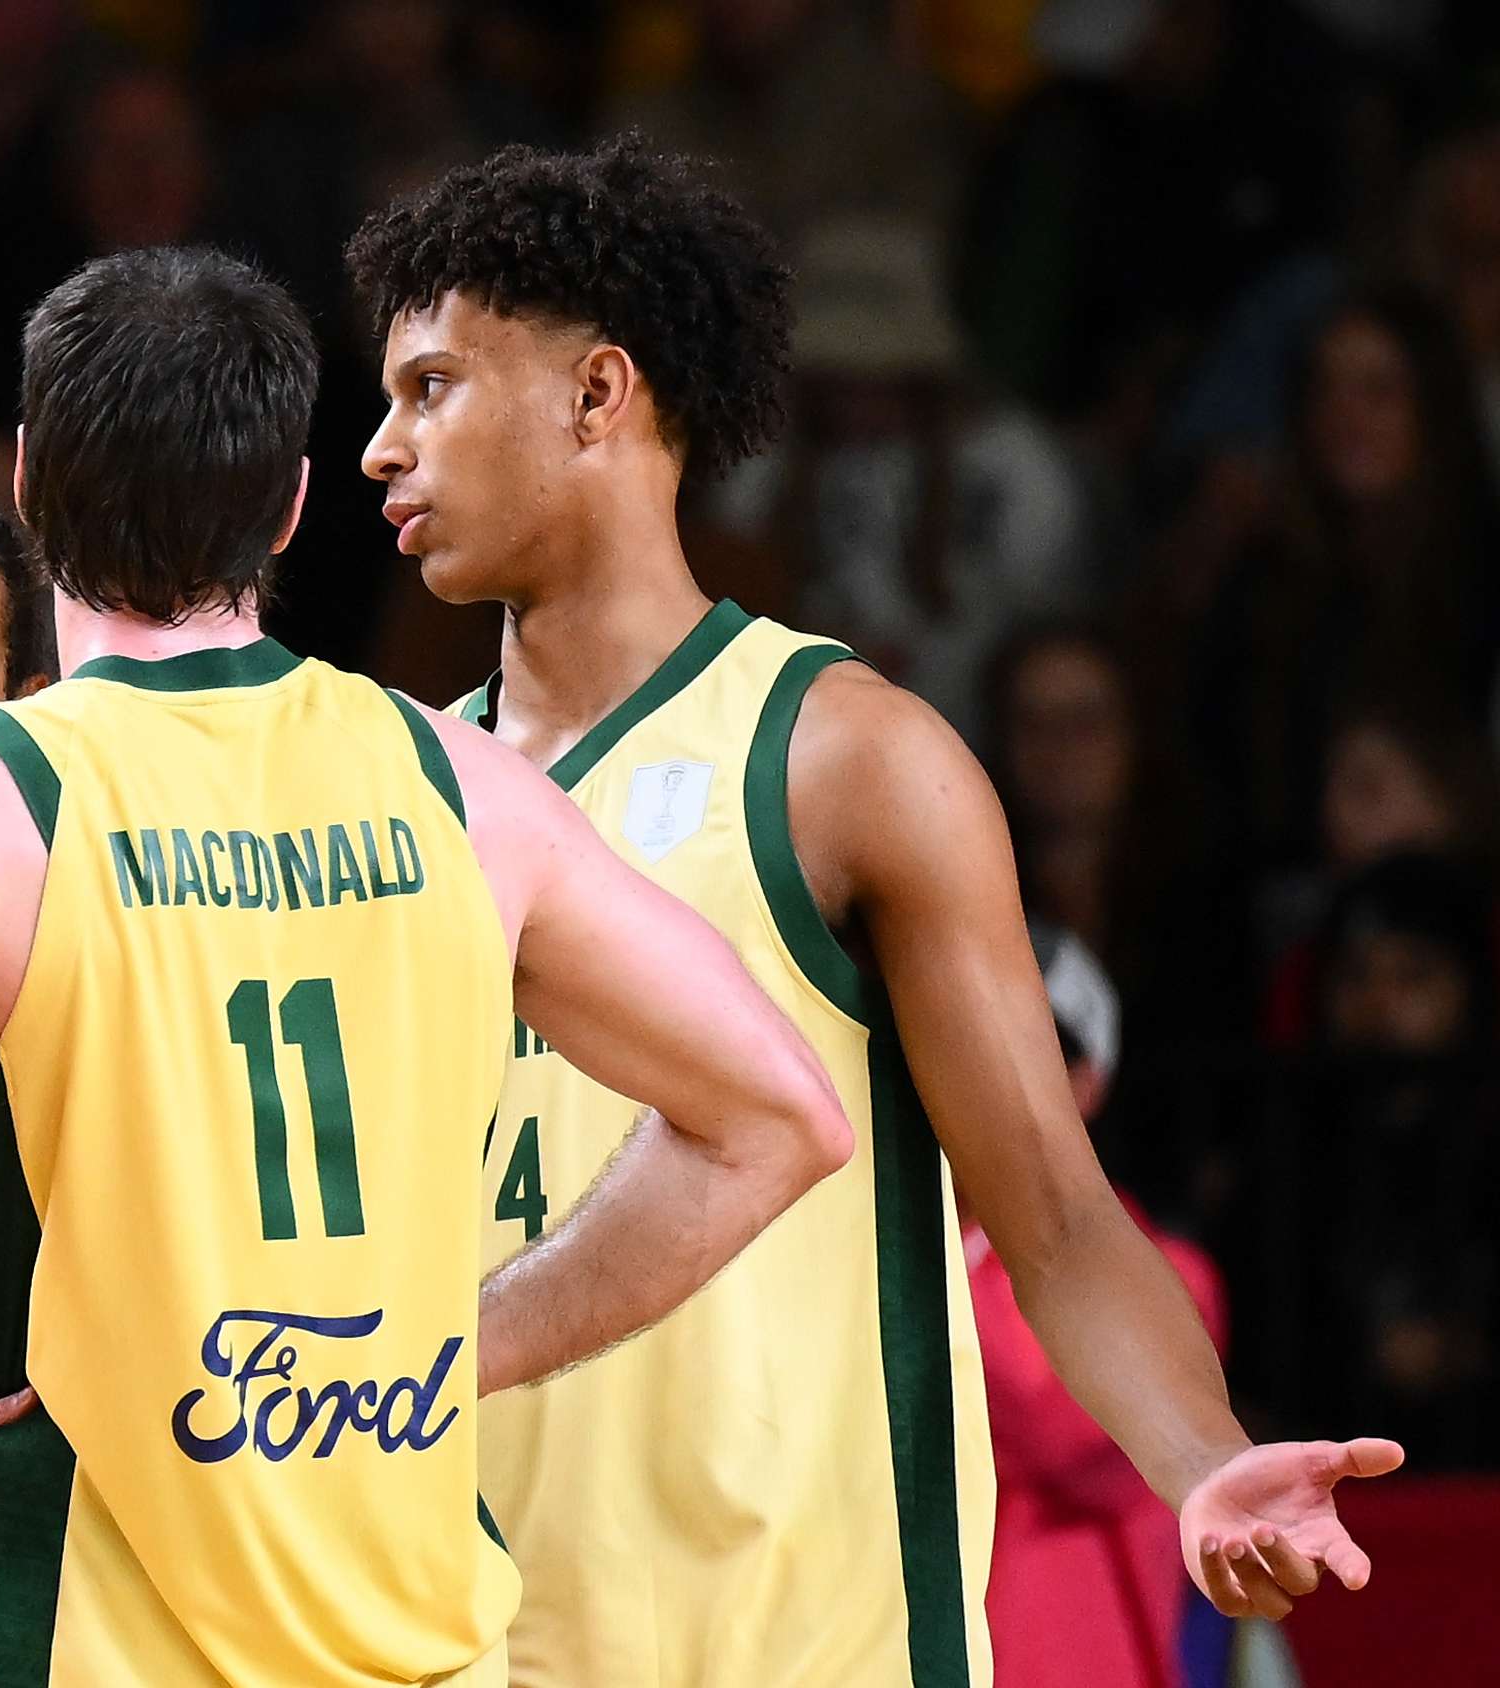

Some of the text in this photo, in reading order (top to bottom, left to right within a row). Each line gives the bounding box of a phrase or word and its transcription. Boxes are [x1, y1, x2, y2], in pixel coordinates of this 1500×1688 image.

[107, 817, 425, 913] MACDONALD
[226, 977, 366, 1240] 11
[171, 1308, 465, 1463] Ford
